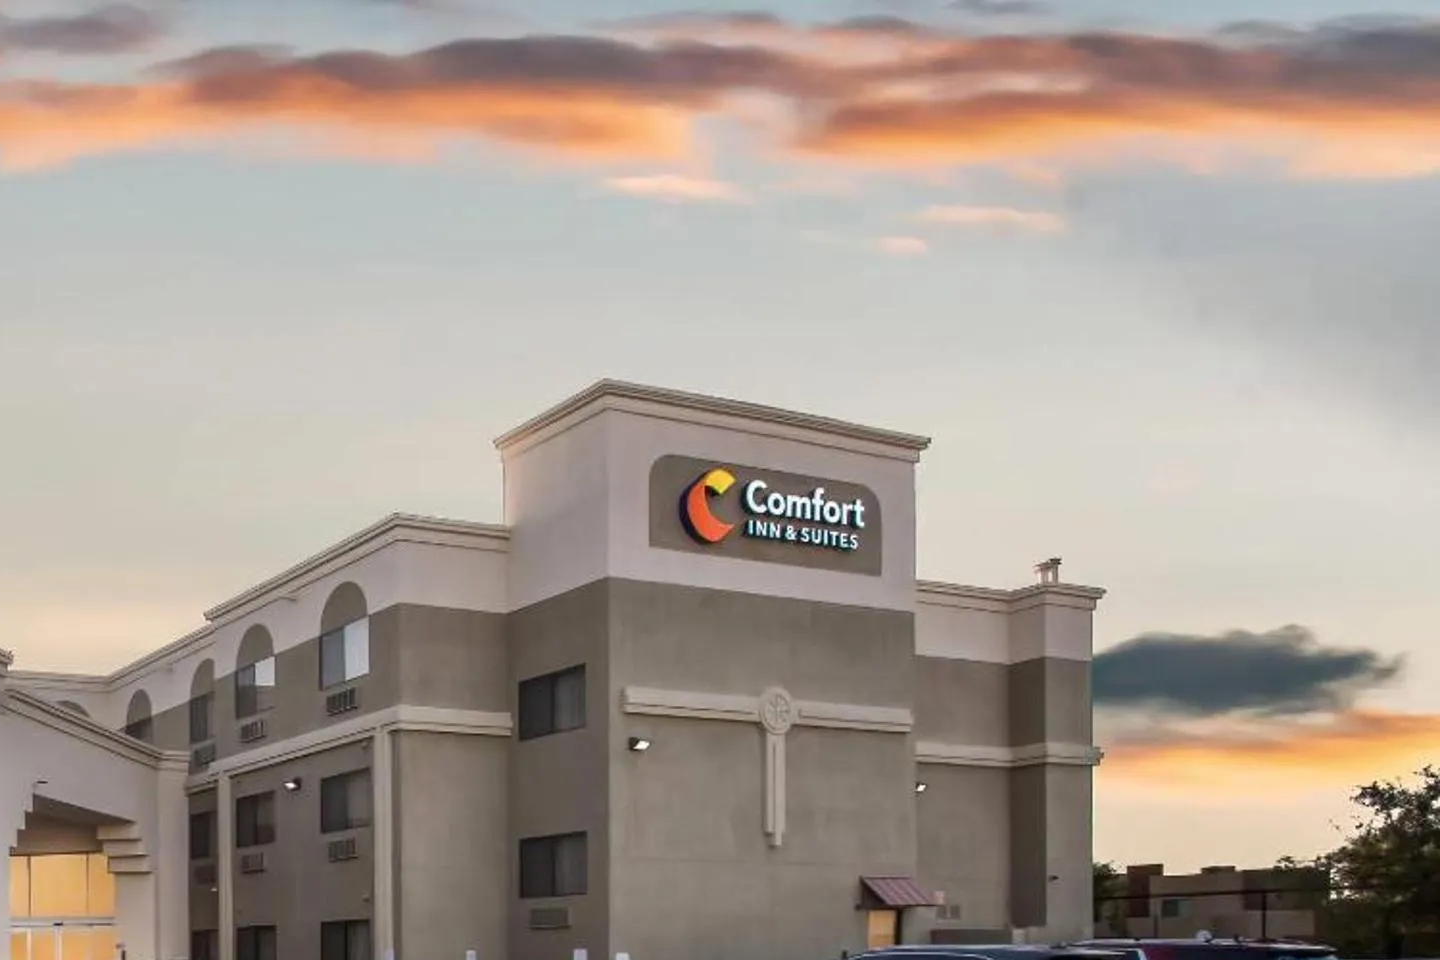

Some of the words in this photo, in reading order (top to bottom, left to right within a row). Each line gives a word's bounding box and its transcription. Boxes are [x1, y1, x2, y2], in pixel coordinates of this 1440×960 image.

[746, 479, 866, 528] Comfort
[748, 519, 781, 539] INN
[784, 525, 796, 541] &
[801, 527, 859, 550] SUITES
